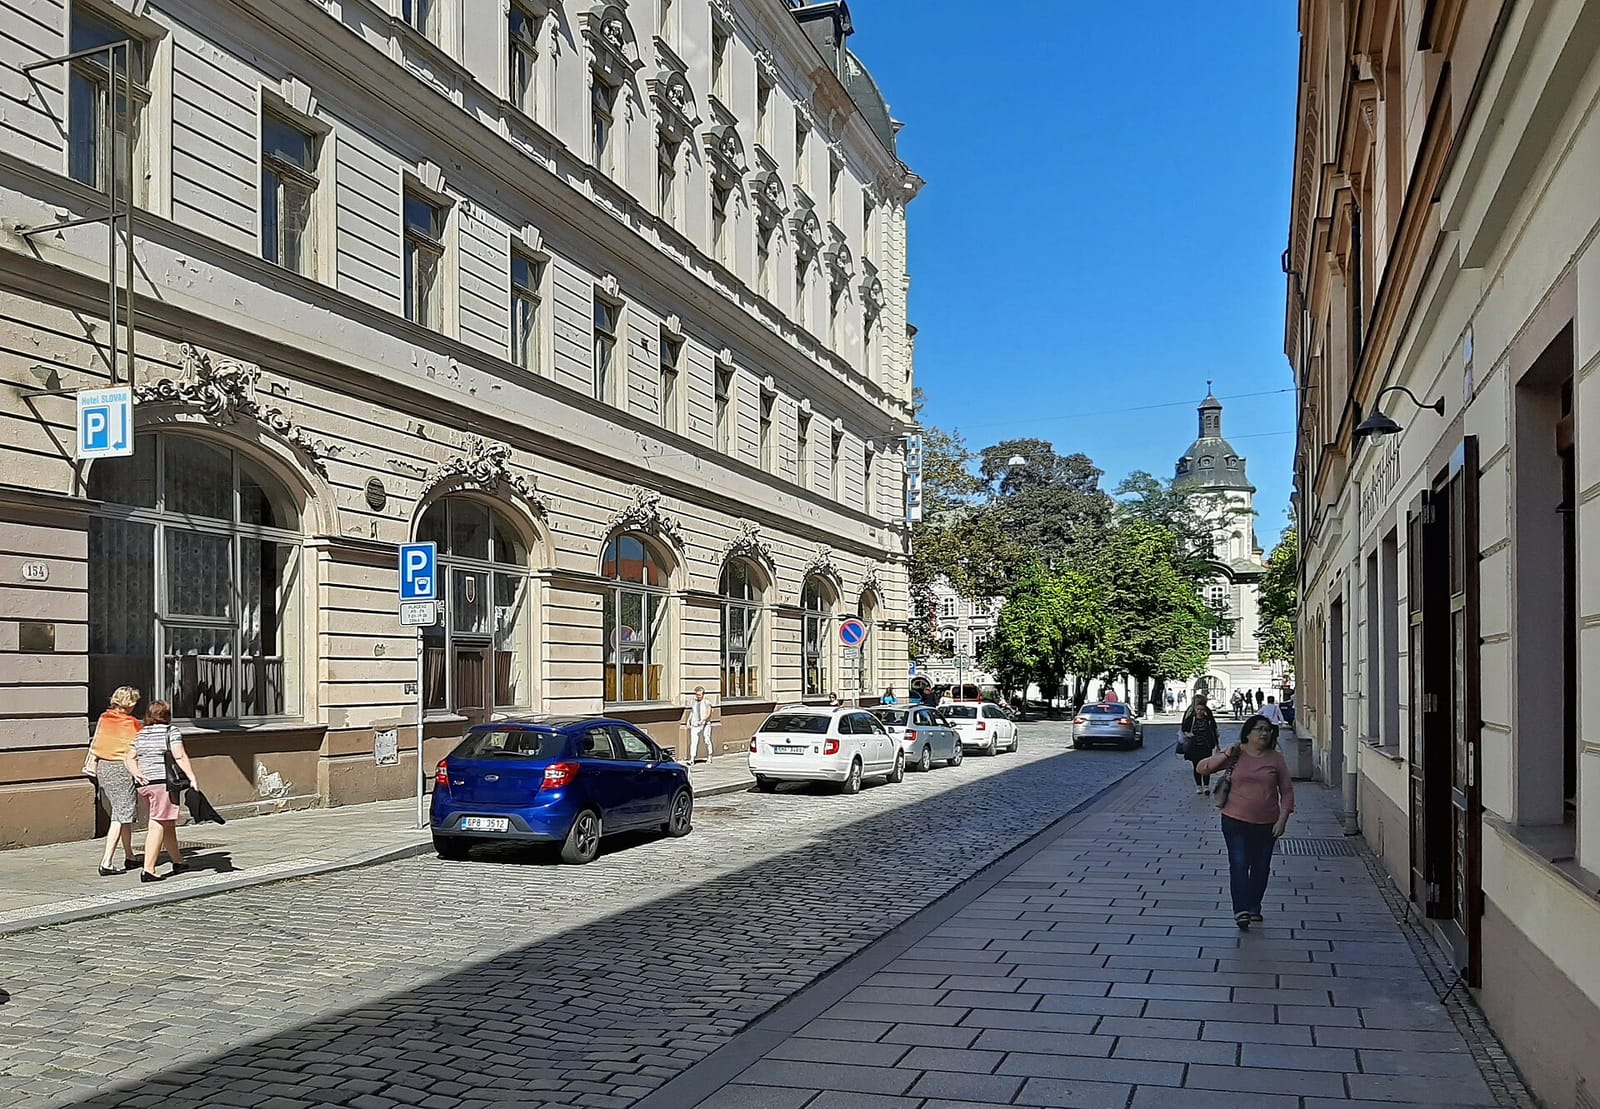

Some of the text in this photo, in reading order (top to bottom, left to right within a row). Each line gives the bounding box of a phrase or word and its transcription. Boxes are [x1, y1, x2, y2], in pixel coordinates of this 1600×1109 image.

[82, 393, 127, 405] Hotel SLOVAN
[87, 413, 105, 445] P
[28, 565, 44, 577] 154
[407, 550, 427, 582] P
